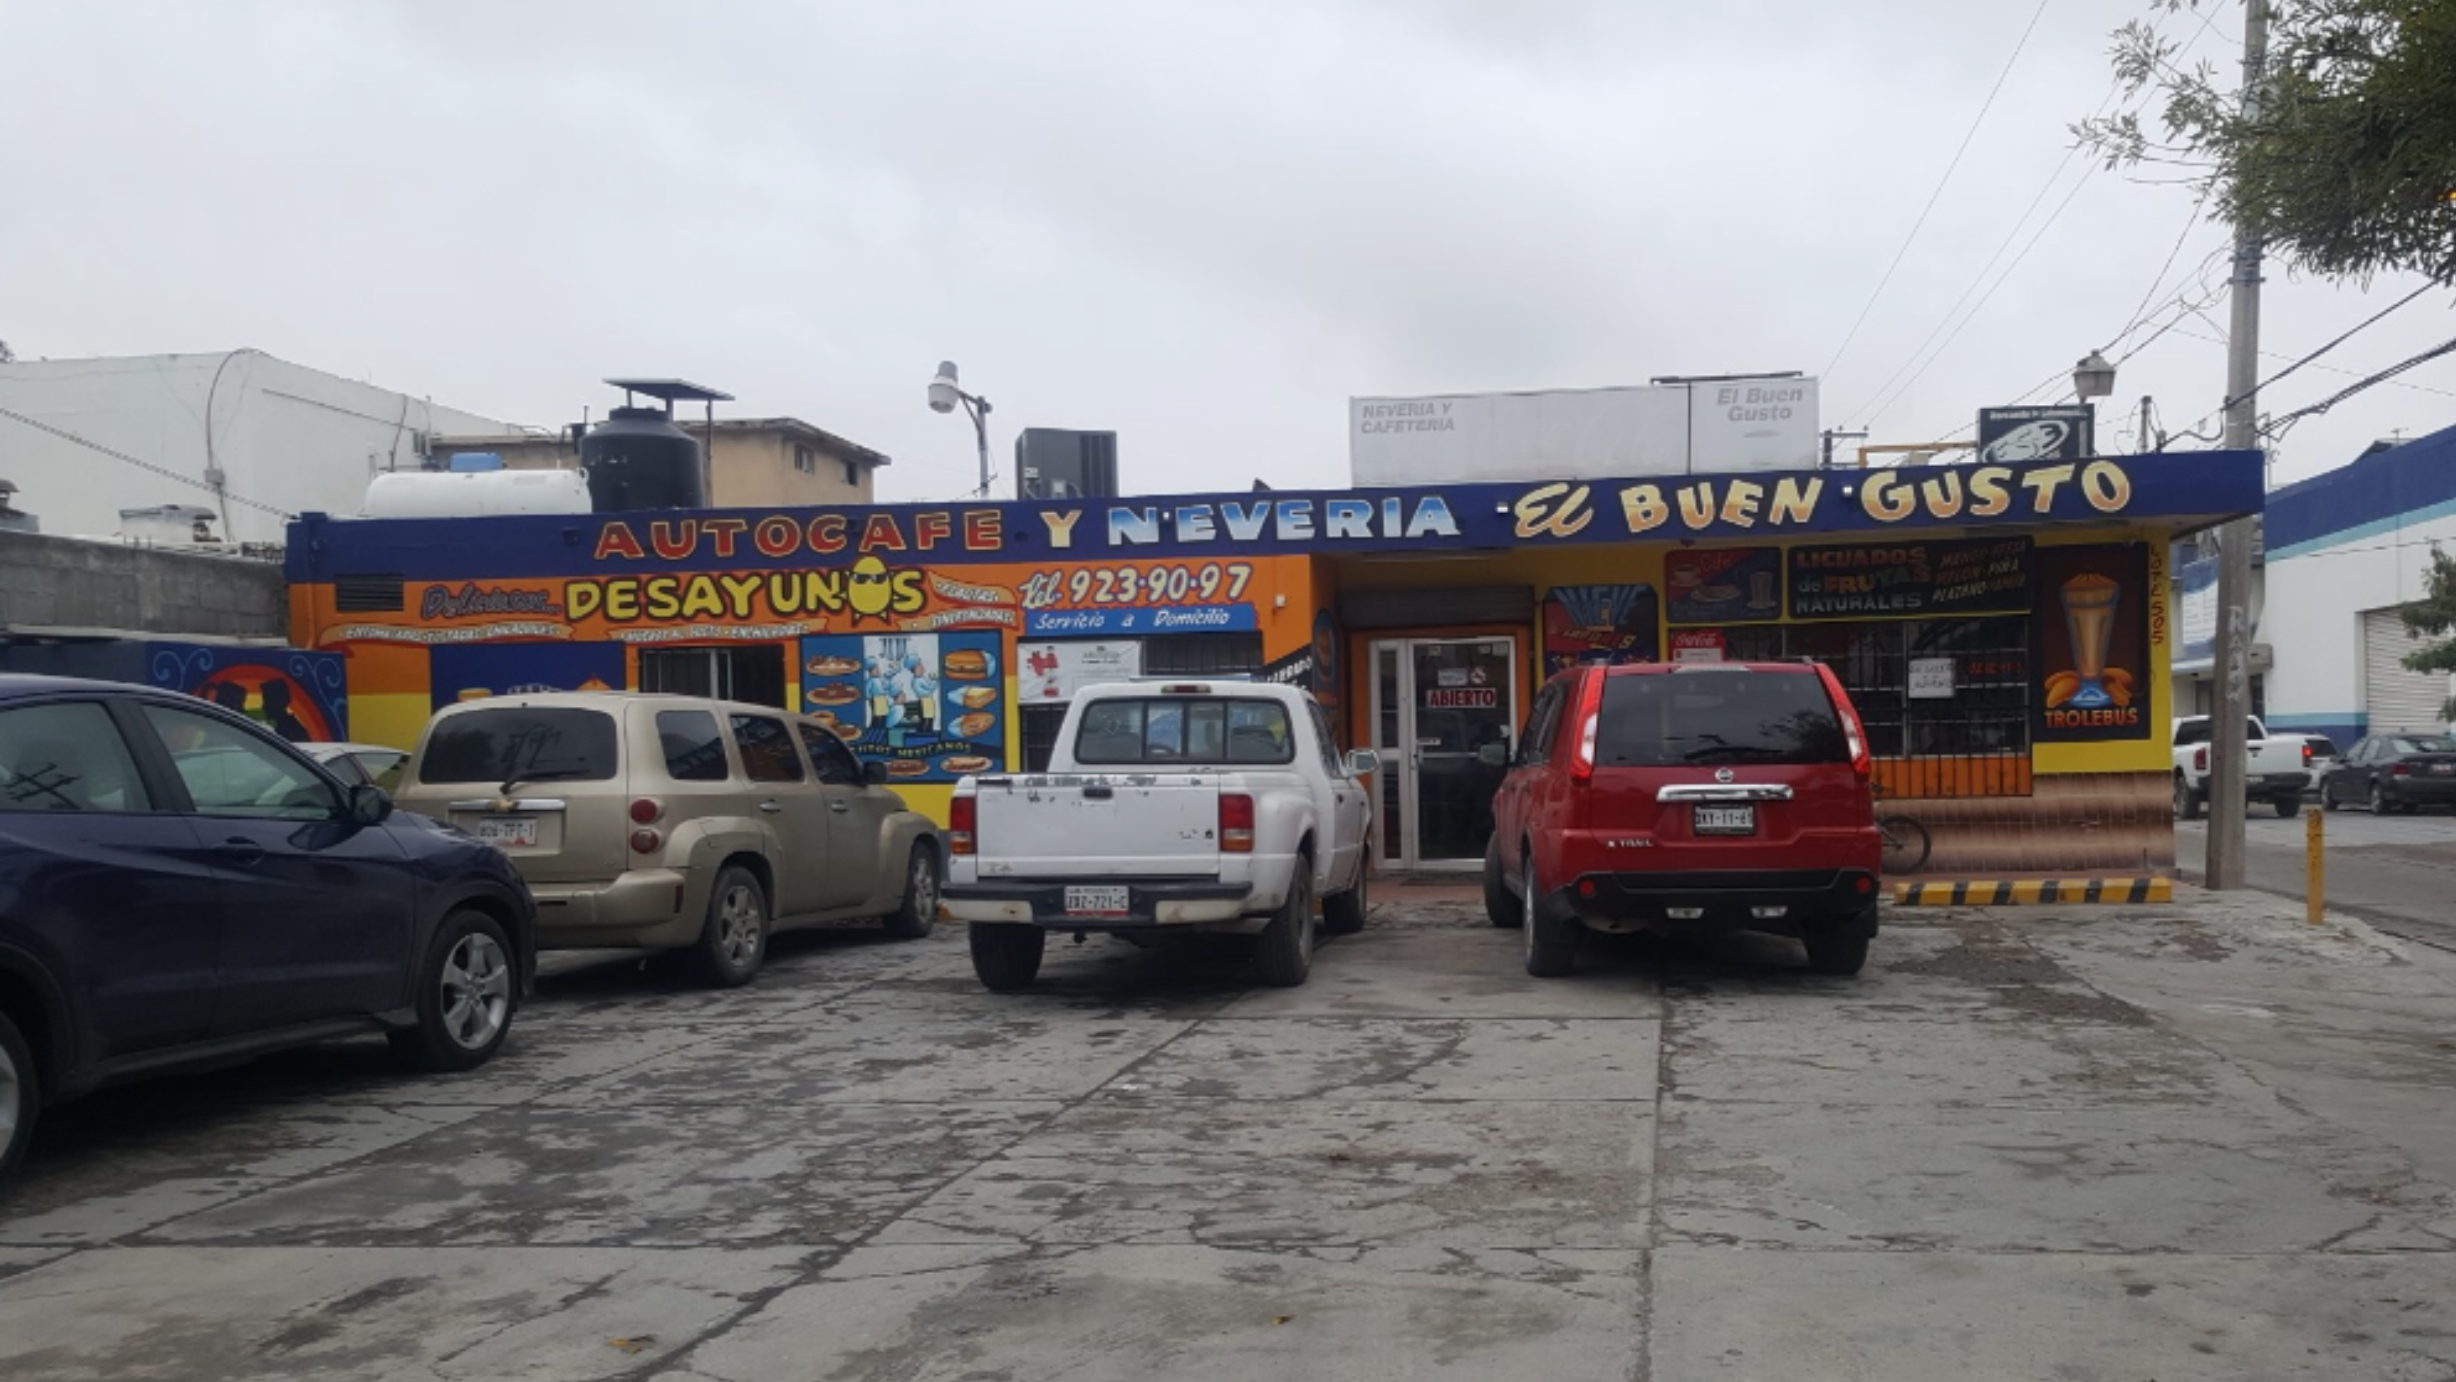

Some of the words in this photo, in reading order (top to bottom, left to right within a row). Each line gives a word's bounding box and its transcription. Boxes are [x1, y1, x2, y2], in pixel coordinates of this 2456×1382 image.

[1717, 388, 1738, 404] El
[1745, 387, 1803, 404] Buen
[1363, 403, 1435, 418] NEVERIA
[1441, 402, 1453, 415] Y
[1728, 405, 1792, 421] Gusto
[1361, 418, 1454, 433] CAFETERIA
[594, 510, 1001, 559] AUTOCAFE
[1039, 510, 1082, 547] Y
[1513, 482, 1594, 538] El
[1619, 477, 1823, 533] BUEN
[1860, 460, 2131, 521] GUSTO
[1797, 547, 1927, 567] LICUADOS
[1824, 565, 1931, 593] FRUTAS
[1797, 593, 1922, 612] NATURALES
[1035, 612, 1105, 630] Servicio
[1154, 609, 1231, 627] Domicilio
[1430, 690, 1494, 706] ABIERTO
[2045, 708, 2137, 728] TROLEBUS
